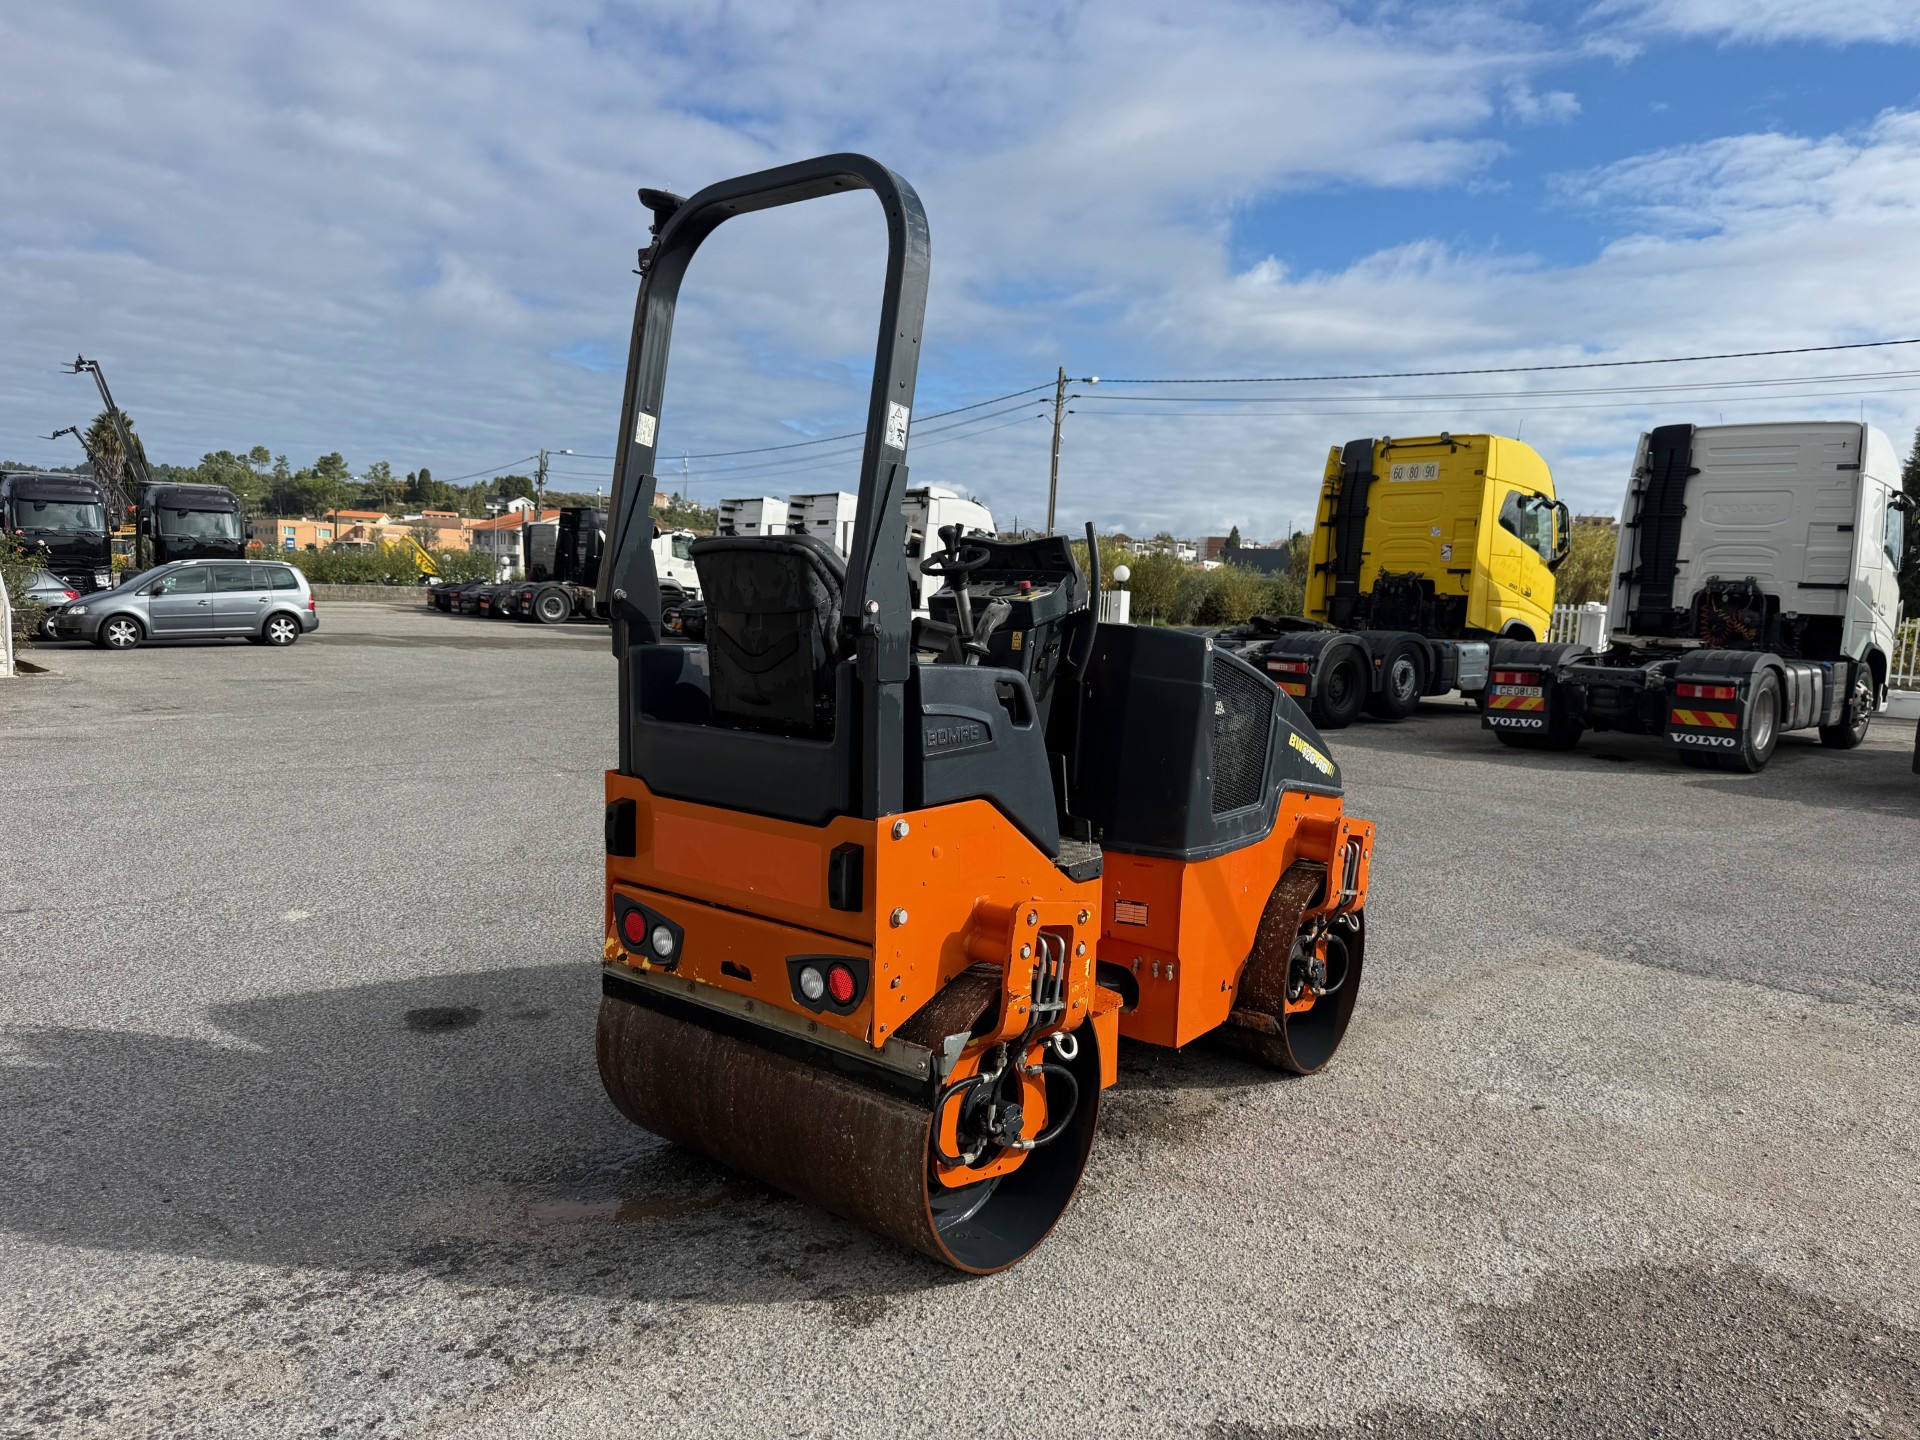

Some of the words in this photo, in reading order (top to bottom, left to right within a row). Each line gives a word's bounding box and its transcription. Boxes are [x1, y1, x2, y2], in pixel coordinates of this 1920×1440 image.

[1393, 467, 1403, 479] 60
[1409, 466, 1419, 479] 80
[1425, 465, 1435, 478] 90
[1487, 716, 1542, 728] VOLVO
[925, 725, 980, 747] BOMAG
[1670, 732, 1736, 748] VOLVO
[1302, 746, 1316, 765] 120
[1316, 758, 1329, 775] AD
